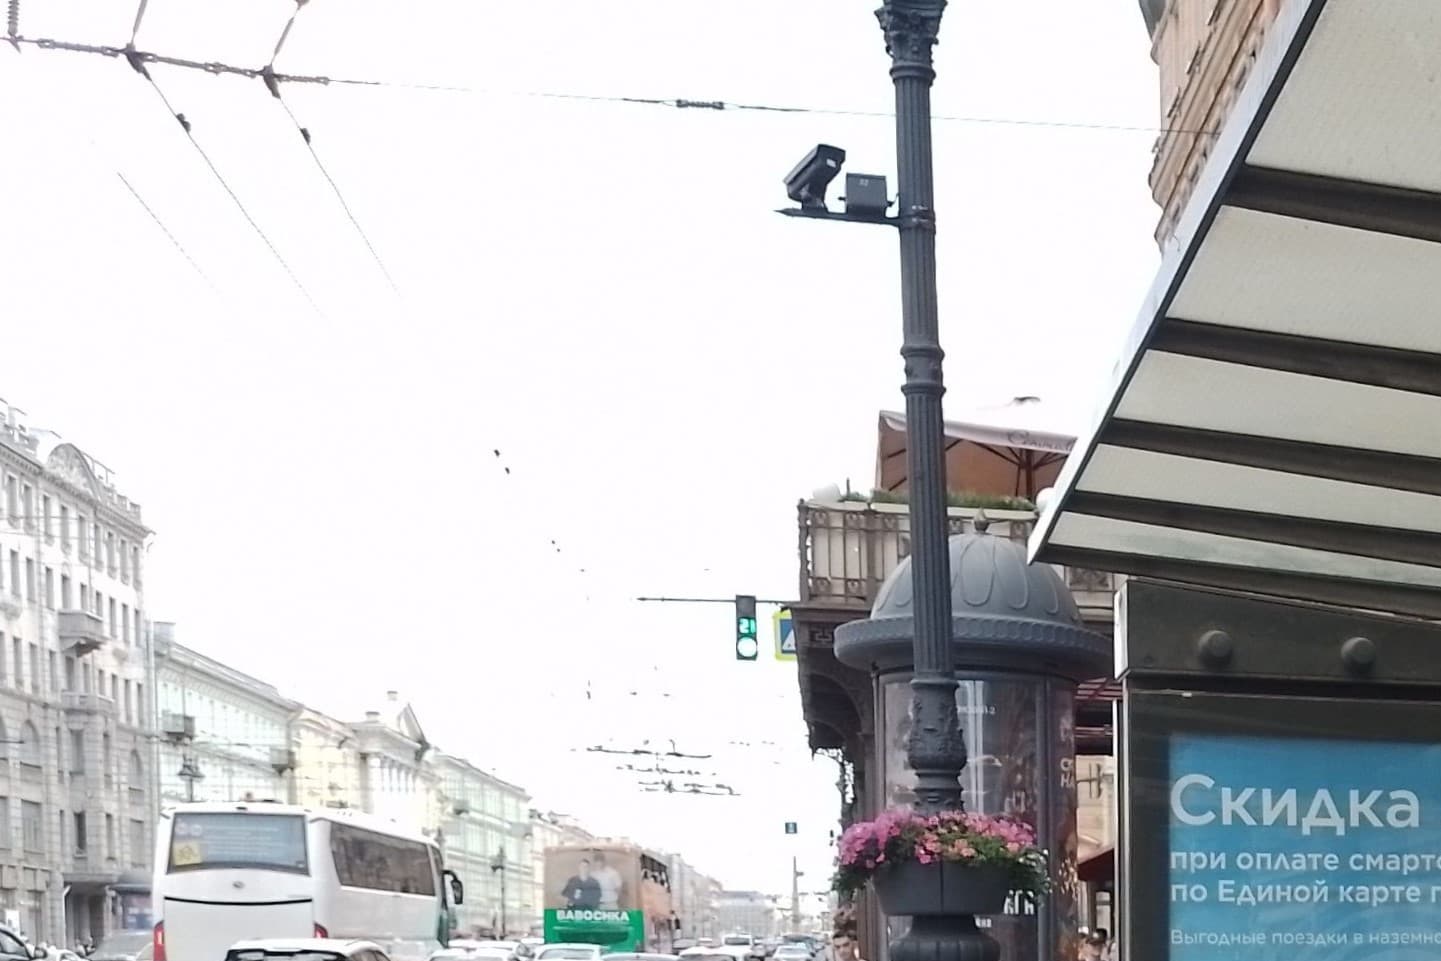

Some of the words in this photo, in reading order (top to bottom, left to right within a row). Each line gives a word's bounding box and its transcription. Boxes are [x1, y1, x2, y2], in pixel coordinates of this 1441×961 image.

[1170, 773, 1420, 836] Скидка
[1170, 849, 1227, 874] при
[1236, 850, 1339, 871] оплате
[1170, 883, 1207, 902] по
[1218, 879, 1329, 906] Единой
[1339, 883, 1421, 907] карте
[1171, 929, 1266, 946] Выгодные
[1272, 929, 1348, 947] поездки
[1354, 931, 1364, 944] в
